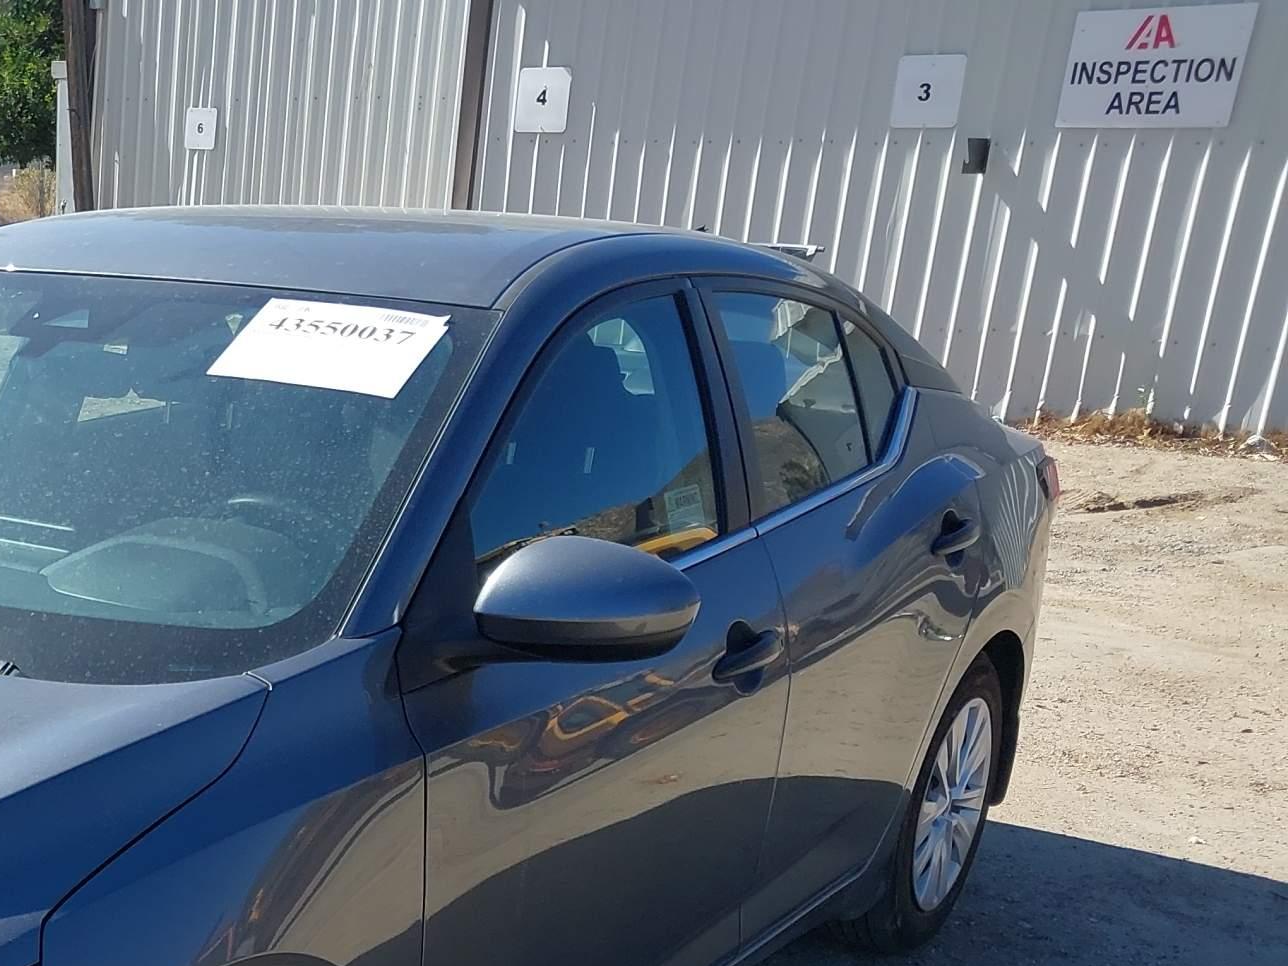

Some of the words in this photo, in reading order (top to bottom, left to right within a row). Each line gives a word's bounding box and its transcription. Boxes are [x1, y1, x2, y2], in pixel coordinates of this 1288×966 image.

[1069, 57, 1238, 85] INSPECTION
[536, 89, 547, 105] 4
[917, 83, 932, 101] 3
[1105, 91, 1181, 115] AREA
[197, 122, 204, 134] 6
[268, 316, 418, 345] 43550037
